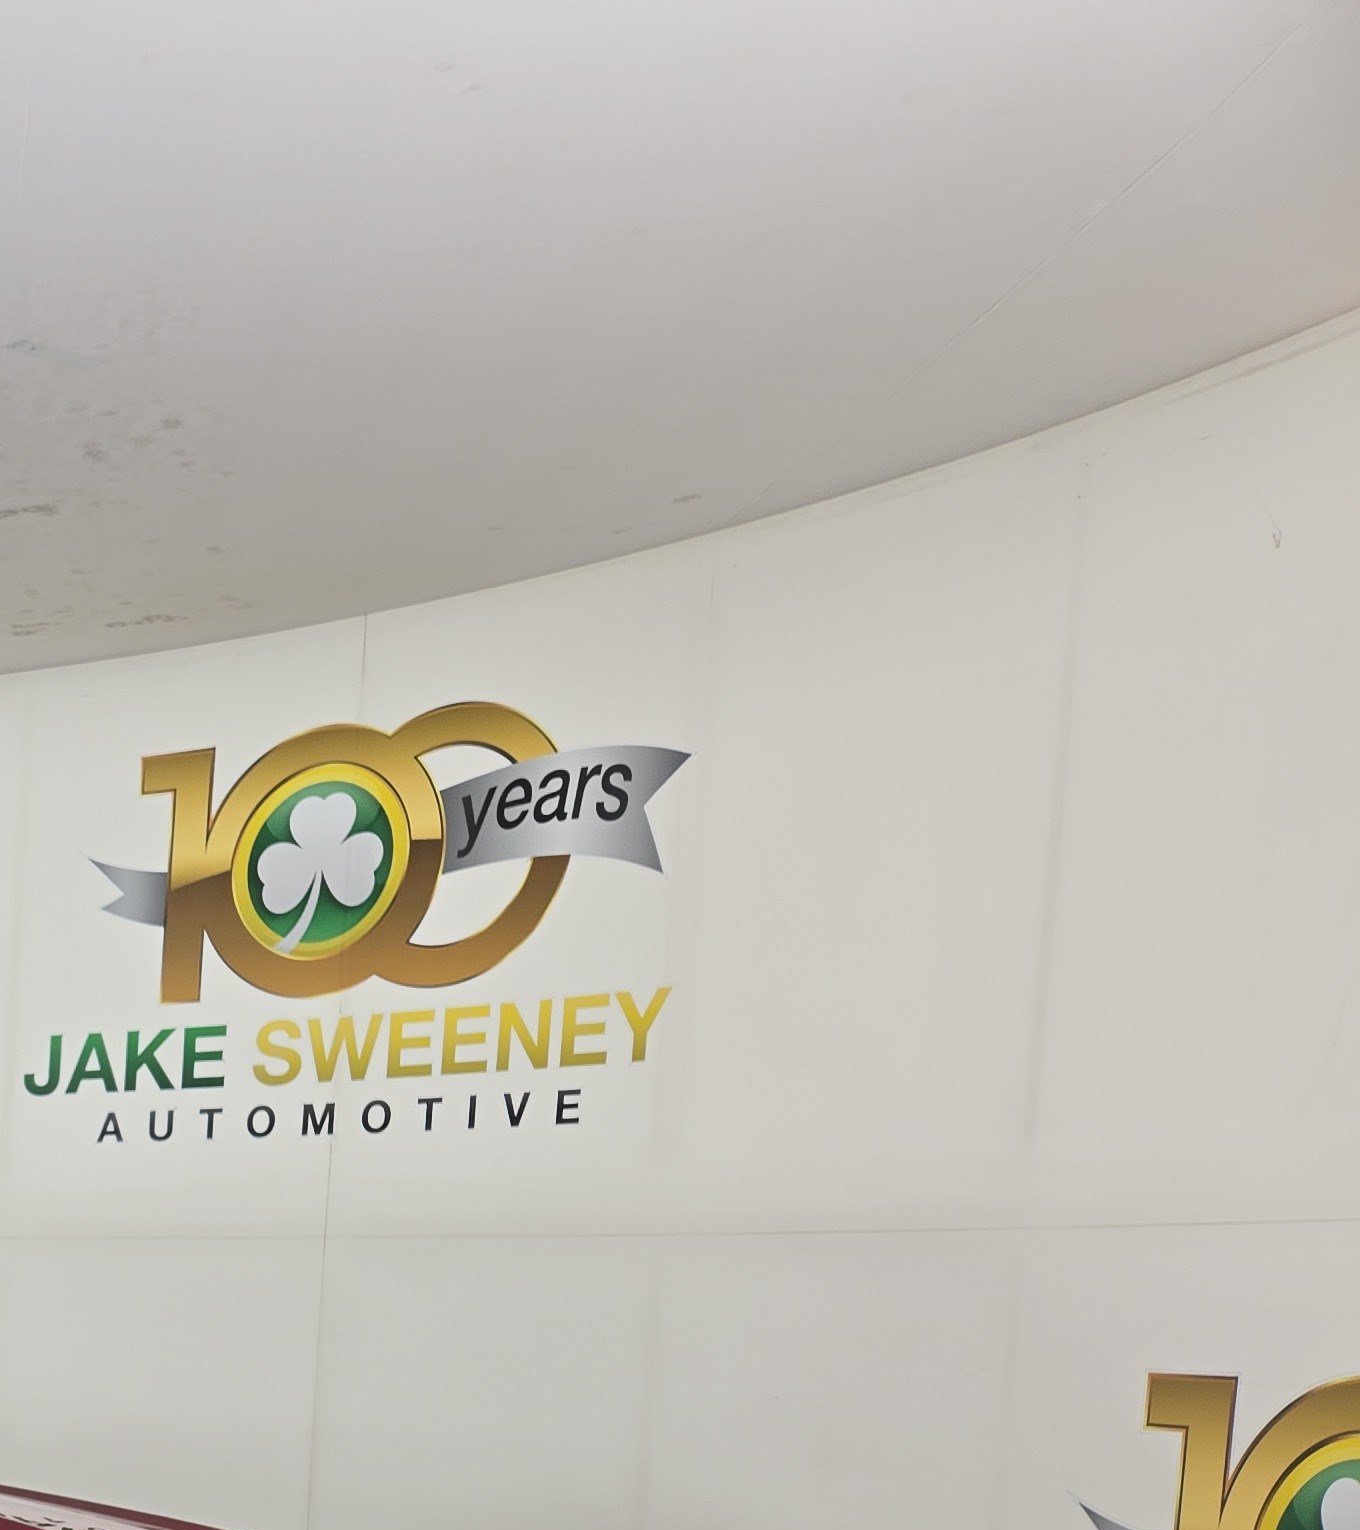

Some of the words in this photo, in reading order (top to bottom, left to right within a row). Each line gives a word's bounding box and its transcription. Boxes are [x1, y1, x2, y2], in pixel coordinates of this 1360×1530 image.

[140, 701, 572, 1003] 100
[457, 760, 634, 858] years
[22, 1025, 229, 1097] JAKE
[250, 985, 673, 1087] SWEENEY
[96, 1088, 583, 1144] AUTOMOTIVE
